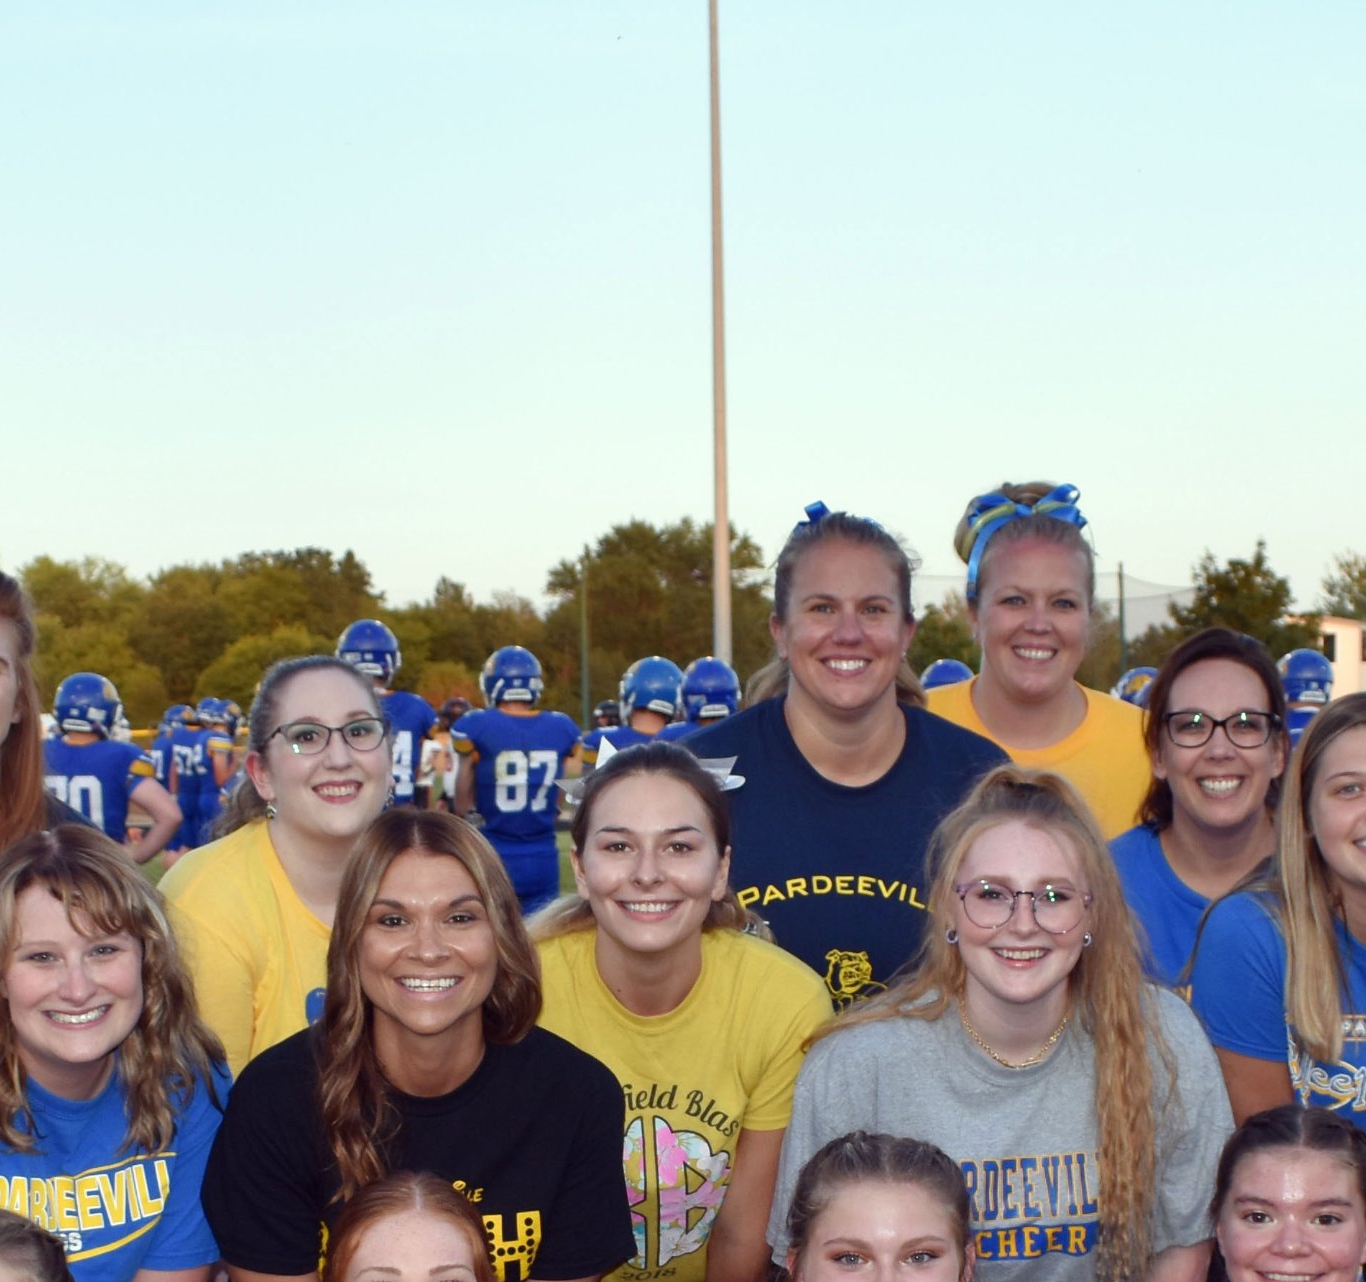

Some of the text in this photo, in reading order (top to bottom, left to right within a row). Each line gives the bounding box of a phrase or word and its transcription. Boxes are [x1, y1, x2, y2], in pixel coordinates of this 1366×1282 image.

[495, 750, 559, 812] 87
[736, 875, 933, 914] PARDEEVIL
[960, 1151, 1100, 1223] RDEEVIL
[975, 1225, 1088, 1259] CHEER
